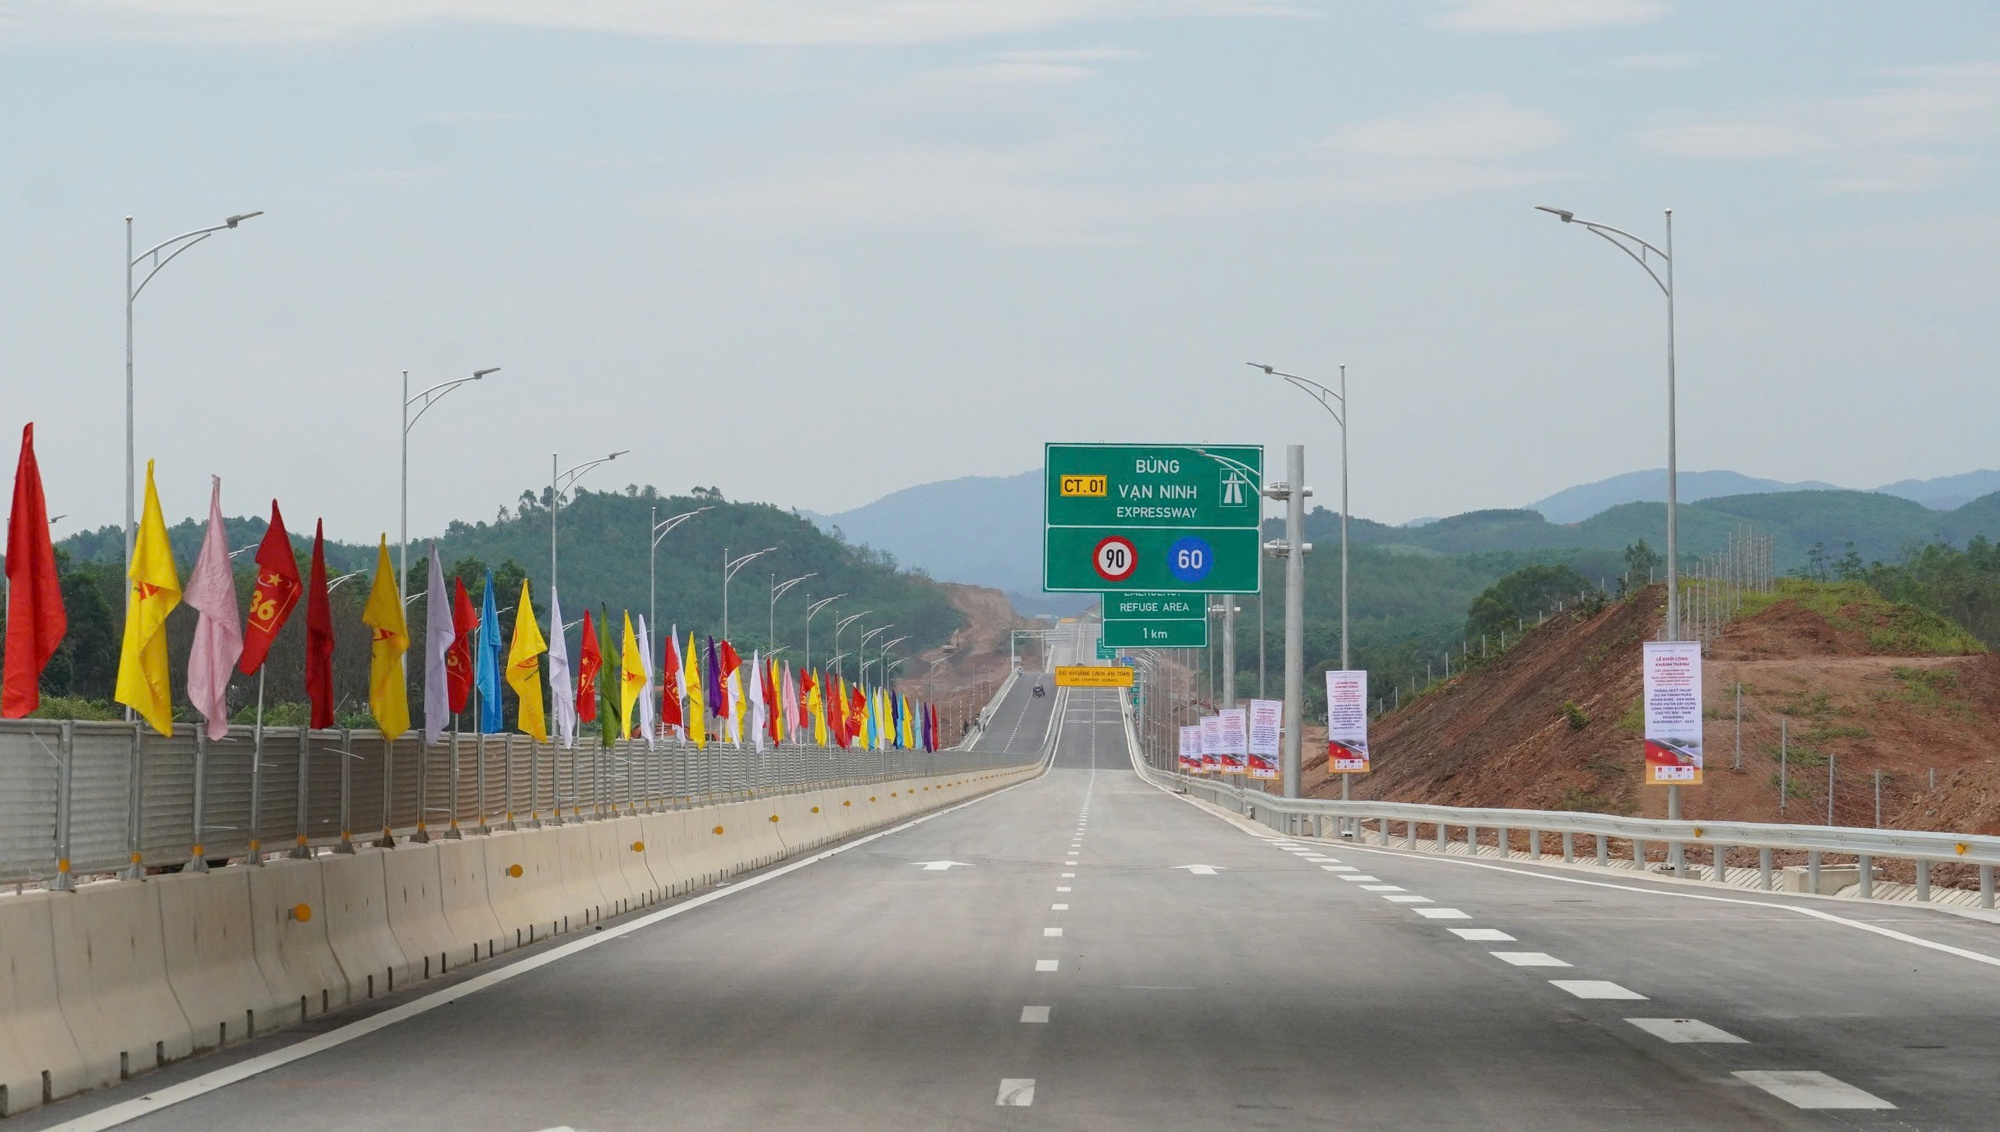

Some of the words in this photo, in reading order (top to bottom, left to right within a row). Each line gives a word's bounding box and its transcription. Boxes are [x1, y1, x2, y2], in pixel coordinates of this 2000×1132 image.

[1136, 456, 1180, 474] BÙNG
[1064, 479, 1104, 493] CT.01
[1118, 484, 1153, 501] VẠN
[1160, 485, 1198, 499] NINH
[1116, 506, 1198, 518] EXPRESSWAY
[1106, 549, 1125, 568] 90
[1178, 549, 1203, 569] 60
[1120, 603, 1158, 612] REFUGE
[1162, 602, 1190, 612] AREA
[1143, 627, 1148, 639] 1
[1151, 629, 1168, 639] km
